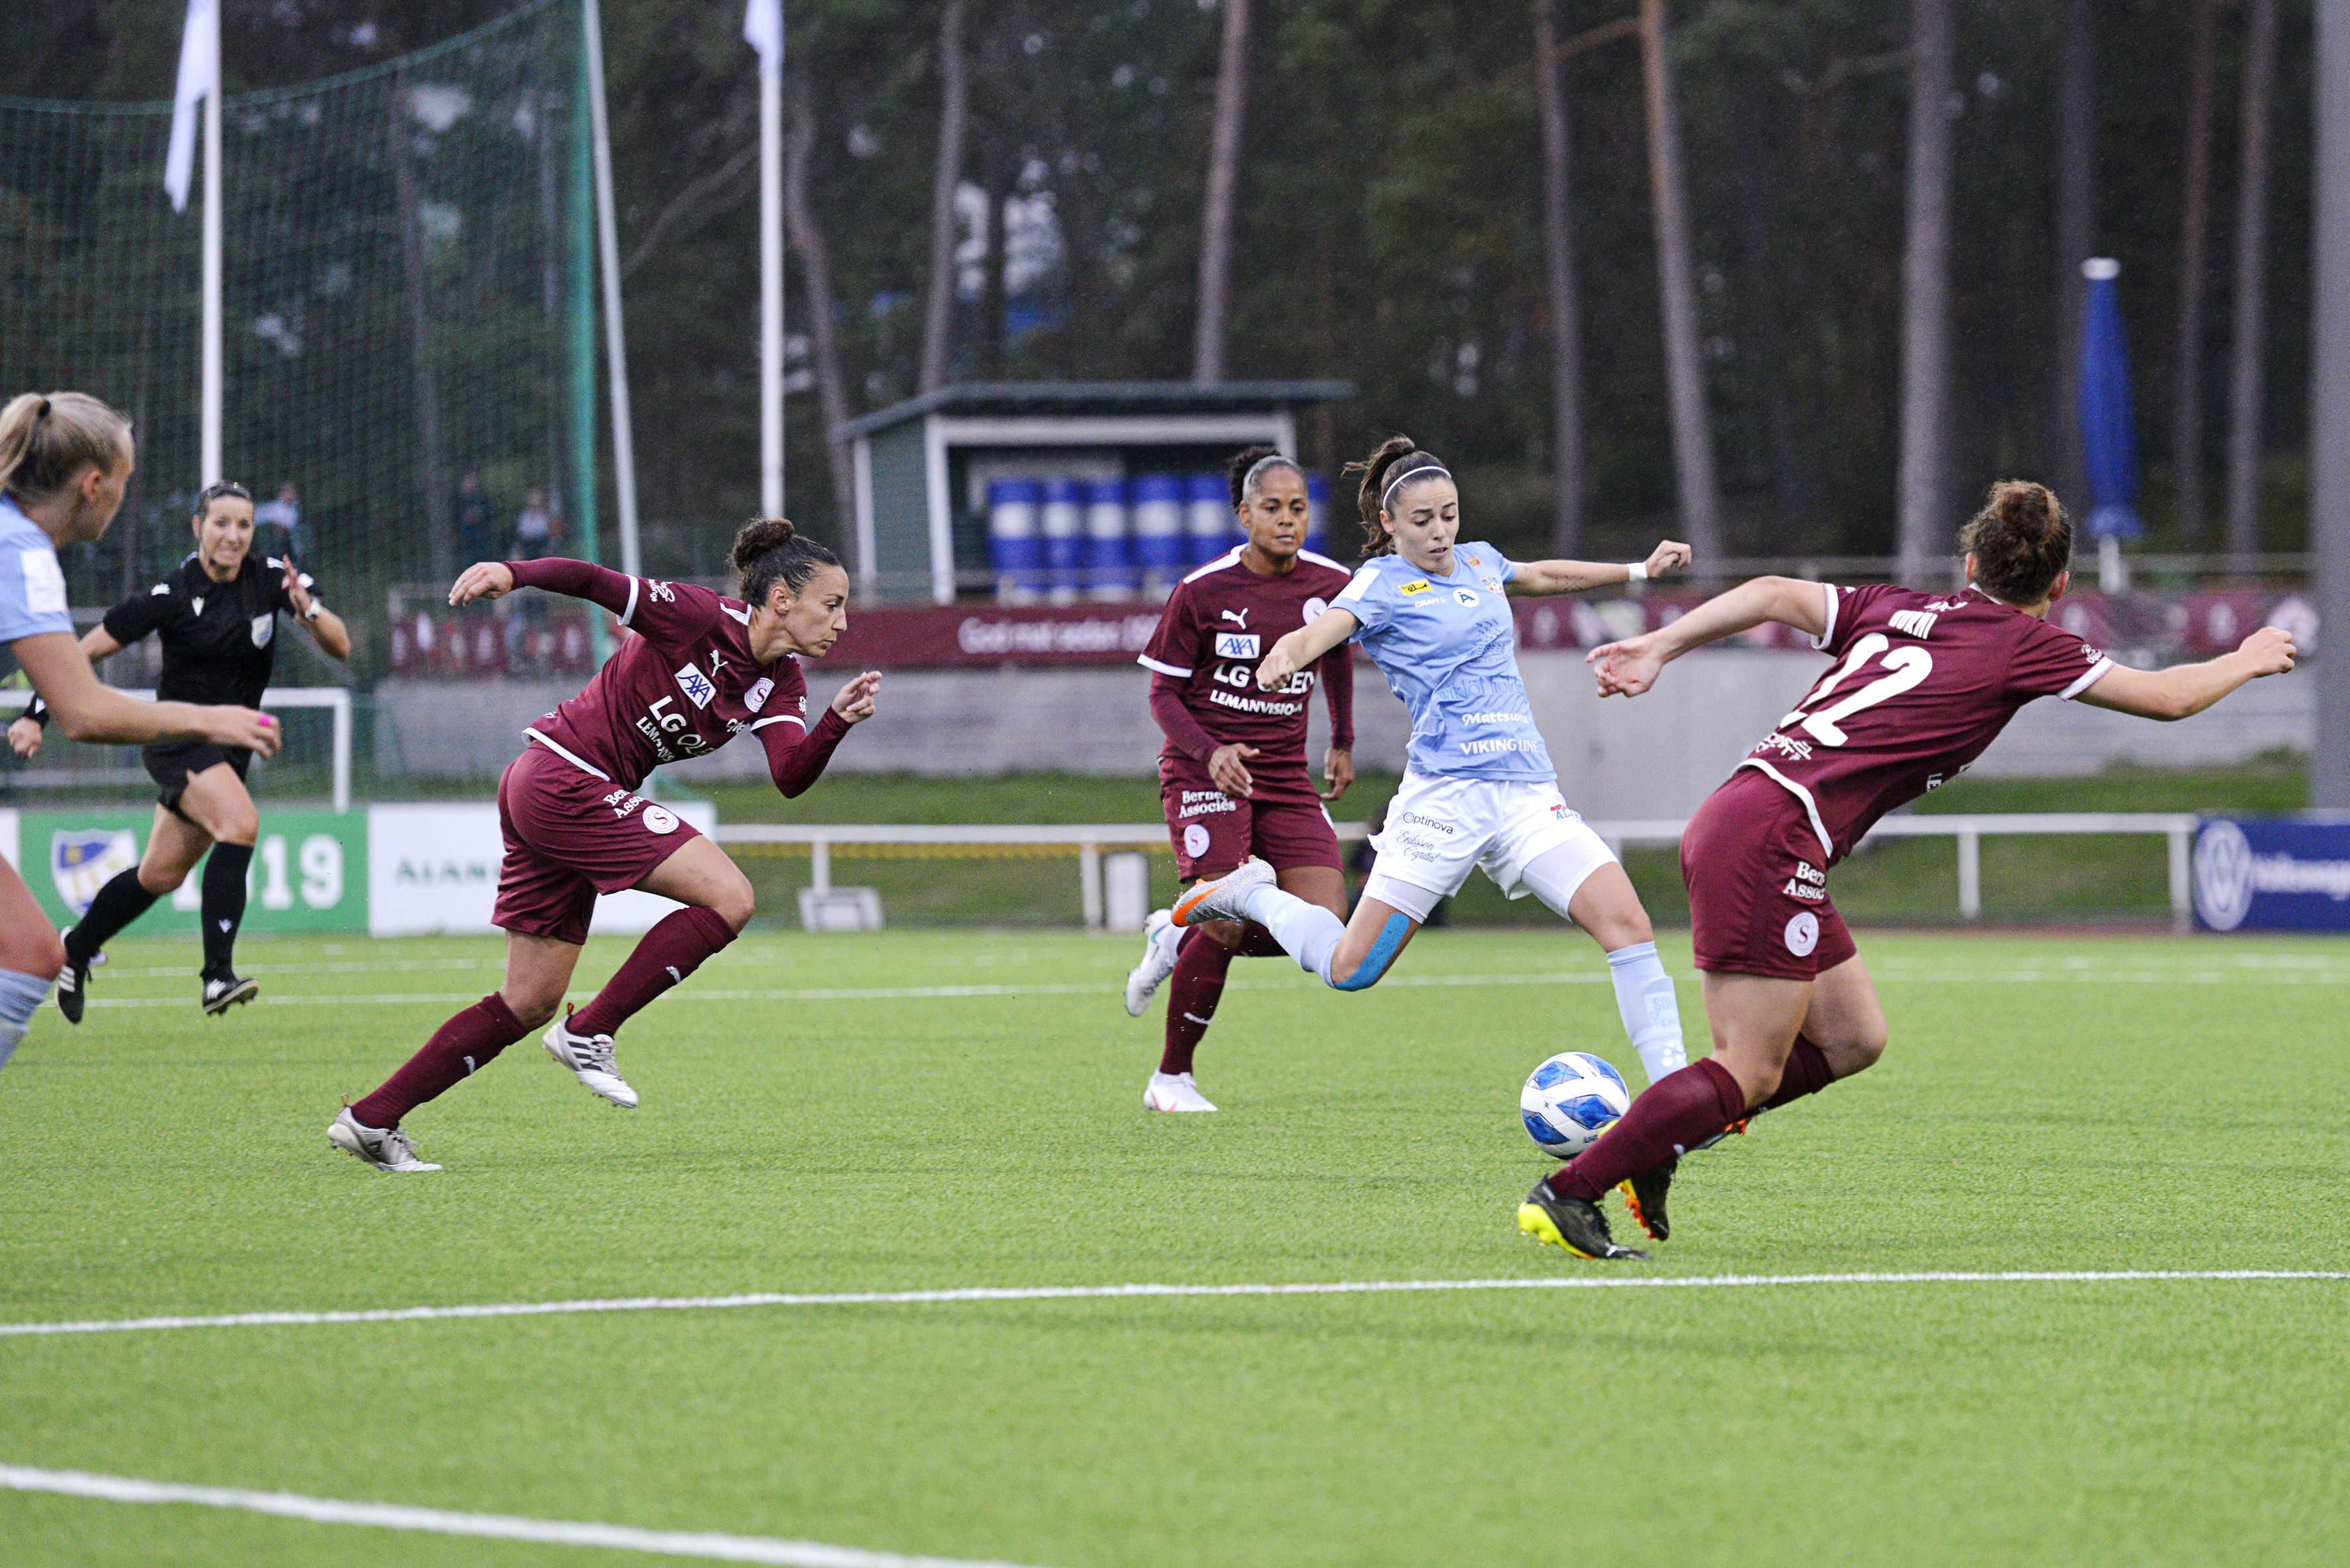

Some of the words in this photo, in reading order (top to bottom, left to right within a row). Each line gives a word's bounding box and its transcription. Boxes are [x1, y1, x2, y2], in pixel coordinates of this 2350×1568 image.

[1414, 598, 1439, 608] CRAFT
[1218, 637, 1256, 656] AXA
[1212, 663, 1252, 688] LG
[677, 673, 712, 706] AXA
[648, 695, 687, 733] LG
[1459, 738, 1517, 755] VIKING
[1518, 739, 1539, 753] LINE
[1403, 812, 1454, 834] Optinova
[1403, 843, 1441, 863] Capital
